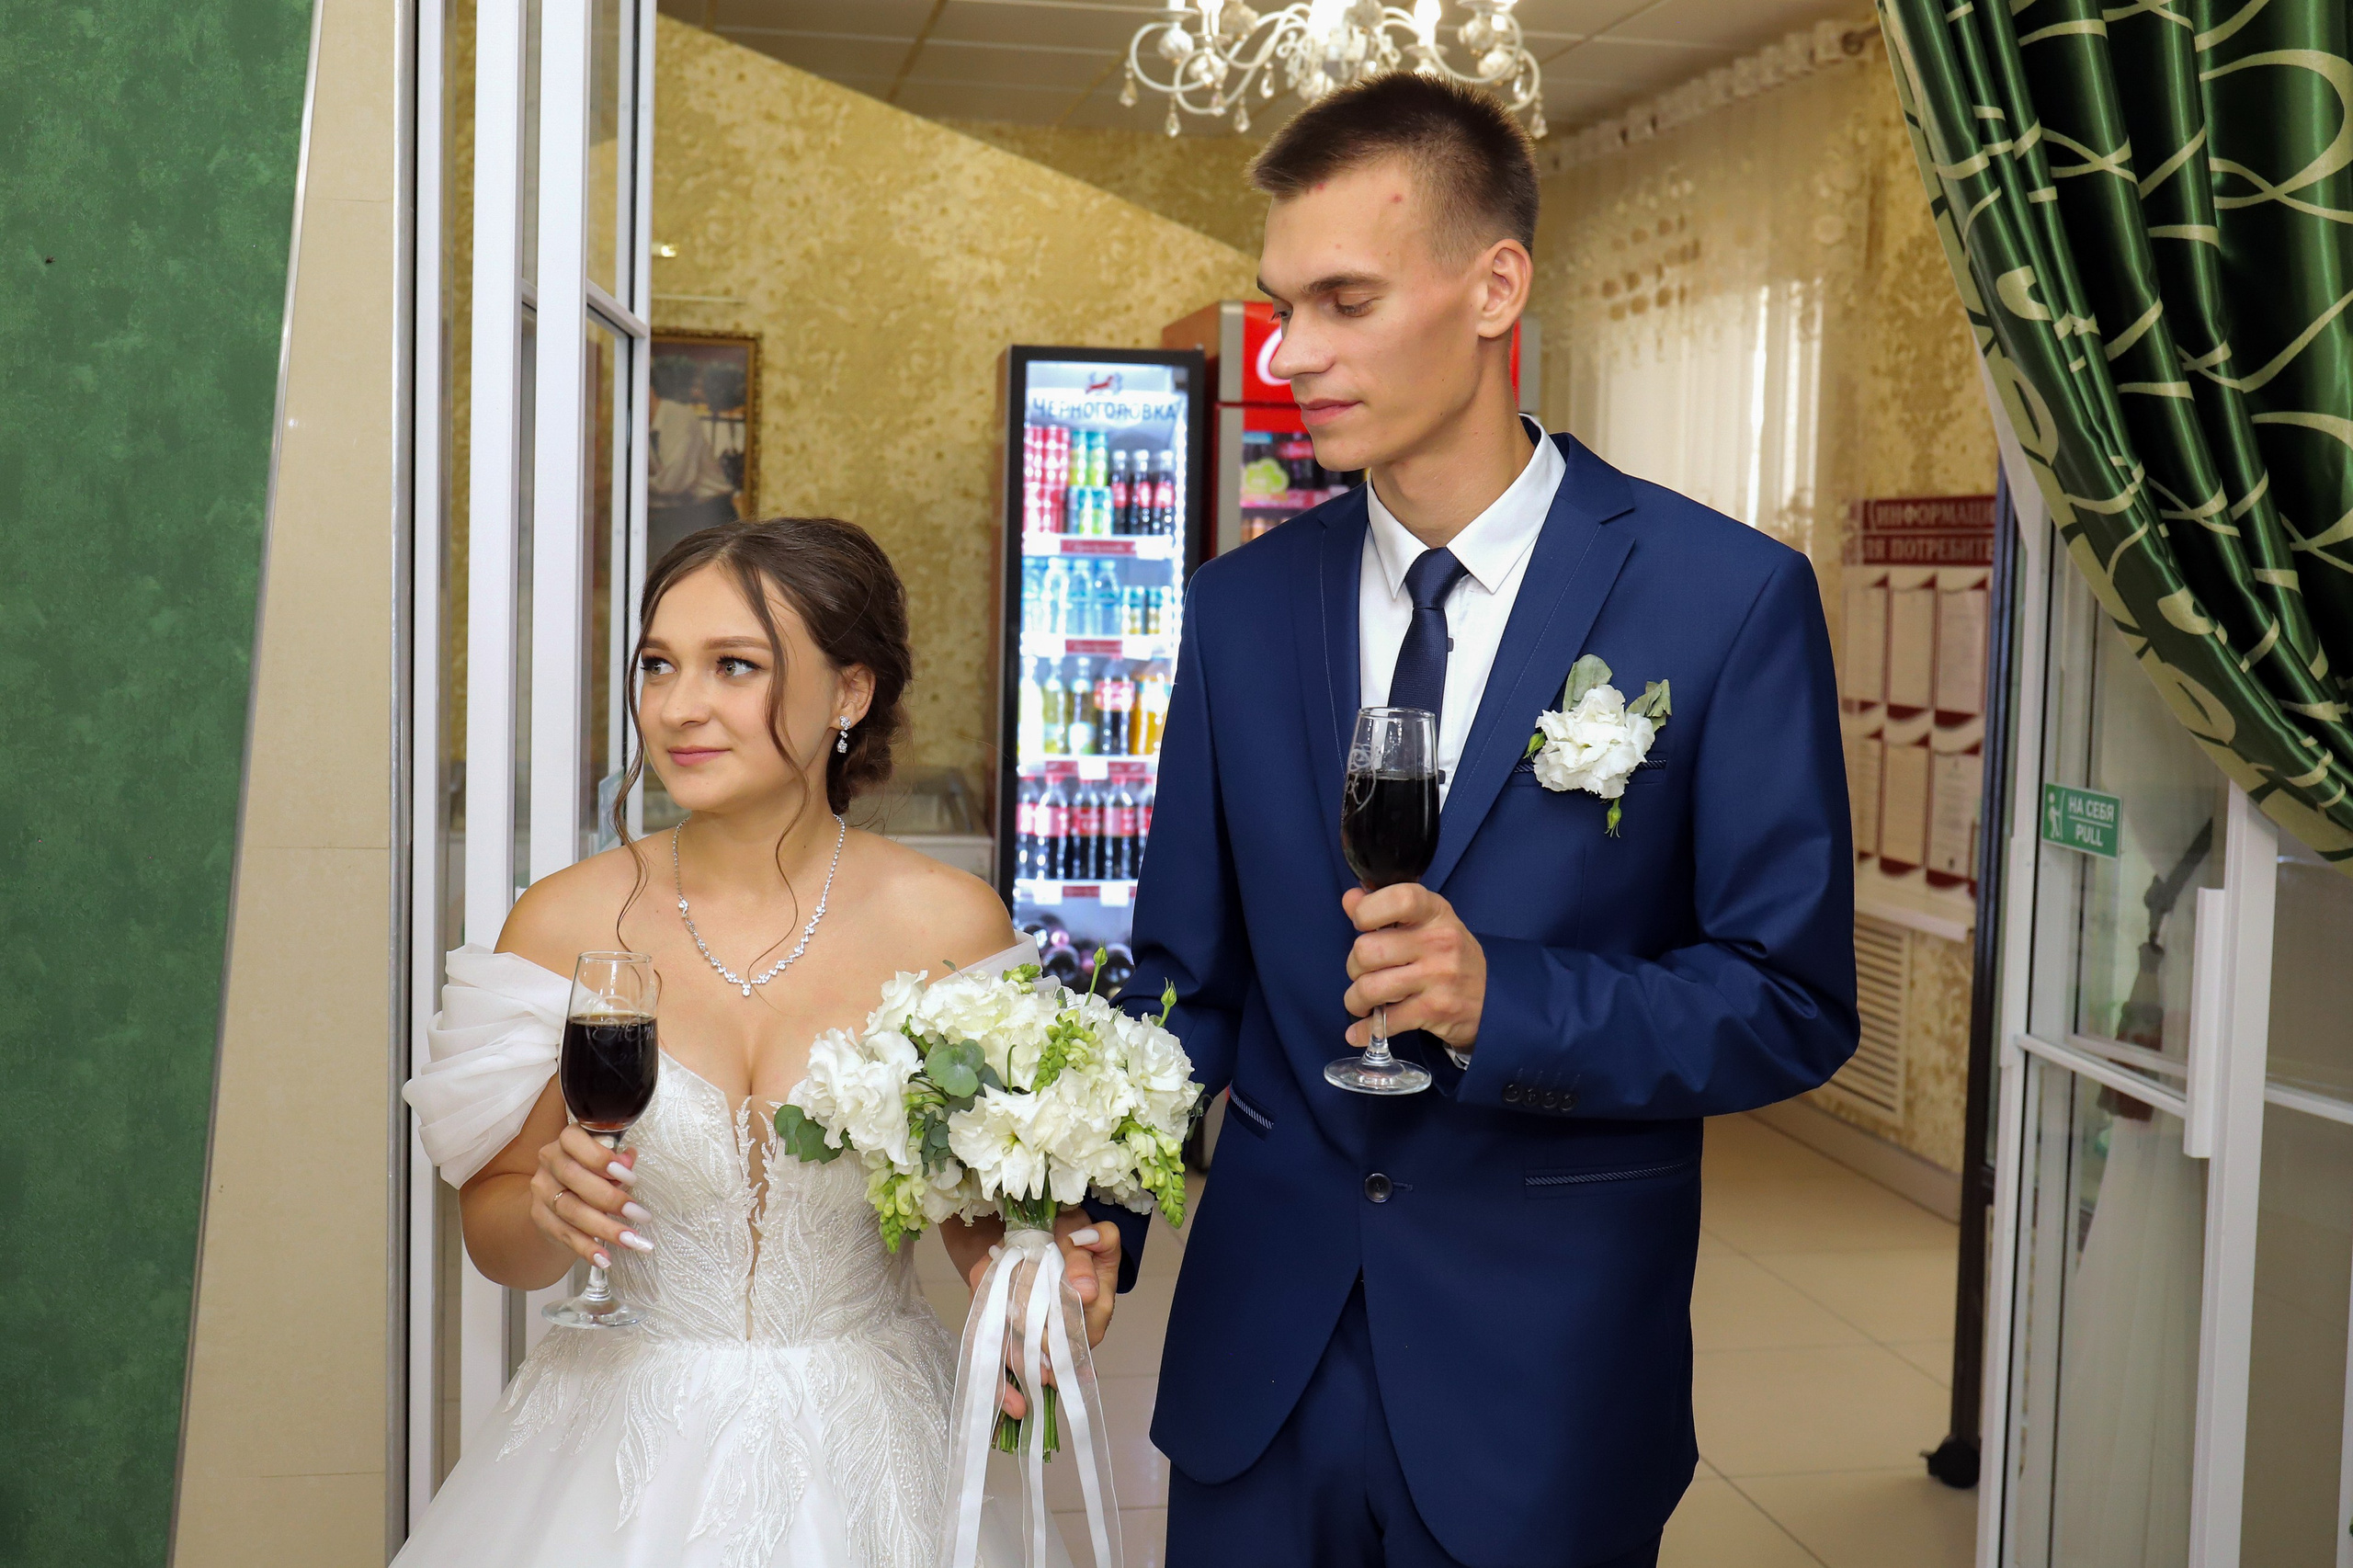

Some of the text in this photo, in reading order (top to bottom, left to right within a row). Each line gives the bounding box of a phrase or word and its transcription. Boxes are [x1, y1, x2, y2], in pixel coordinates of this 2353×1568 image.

[1033, 397, 1176, 420] ЧЕРНОГОЛОВКА
[1876, 502, 1995, 528] ИНФОРМАЦИ
[1891, 537, 1995, 562] ПОТРЕБИТЕ
[2068, 796, 2114, 822] НА СЕБЯ
[2075, 824, 2103, 846] PULL
